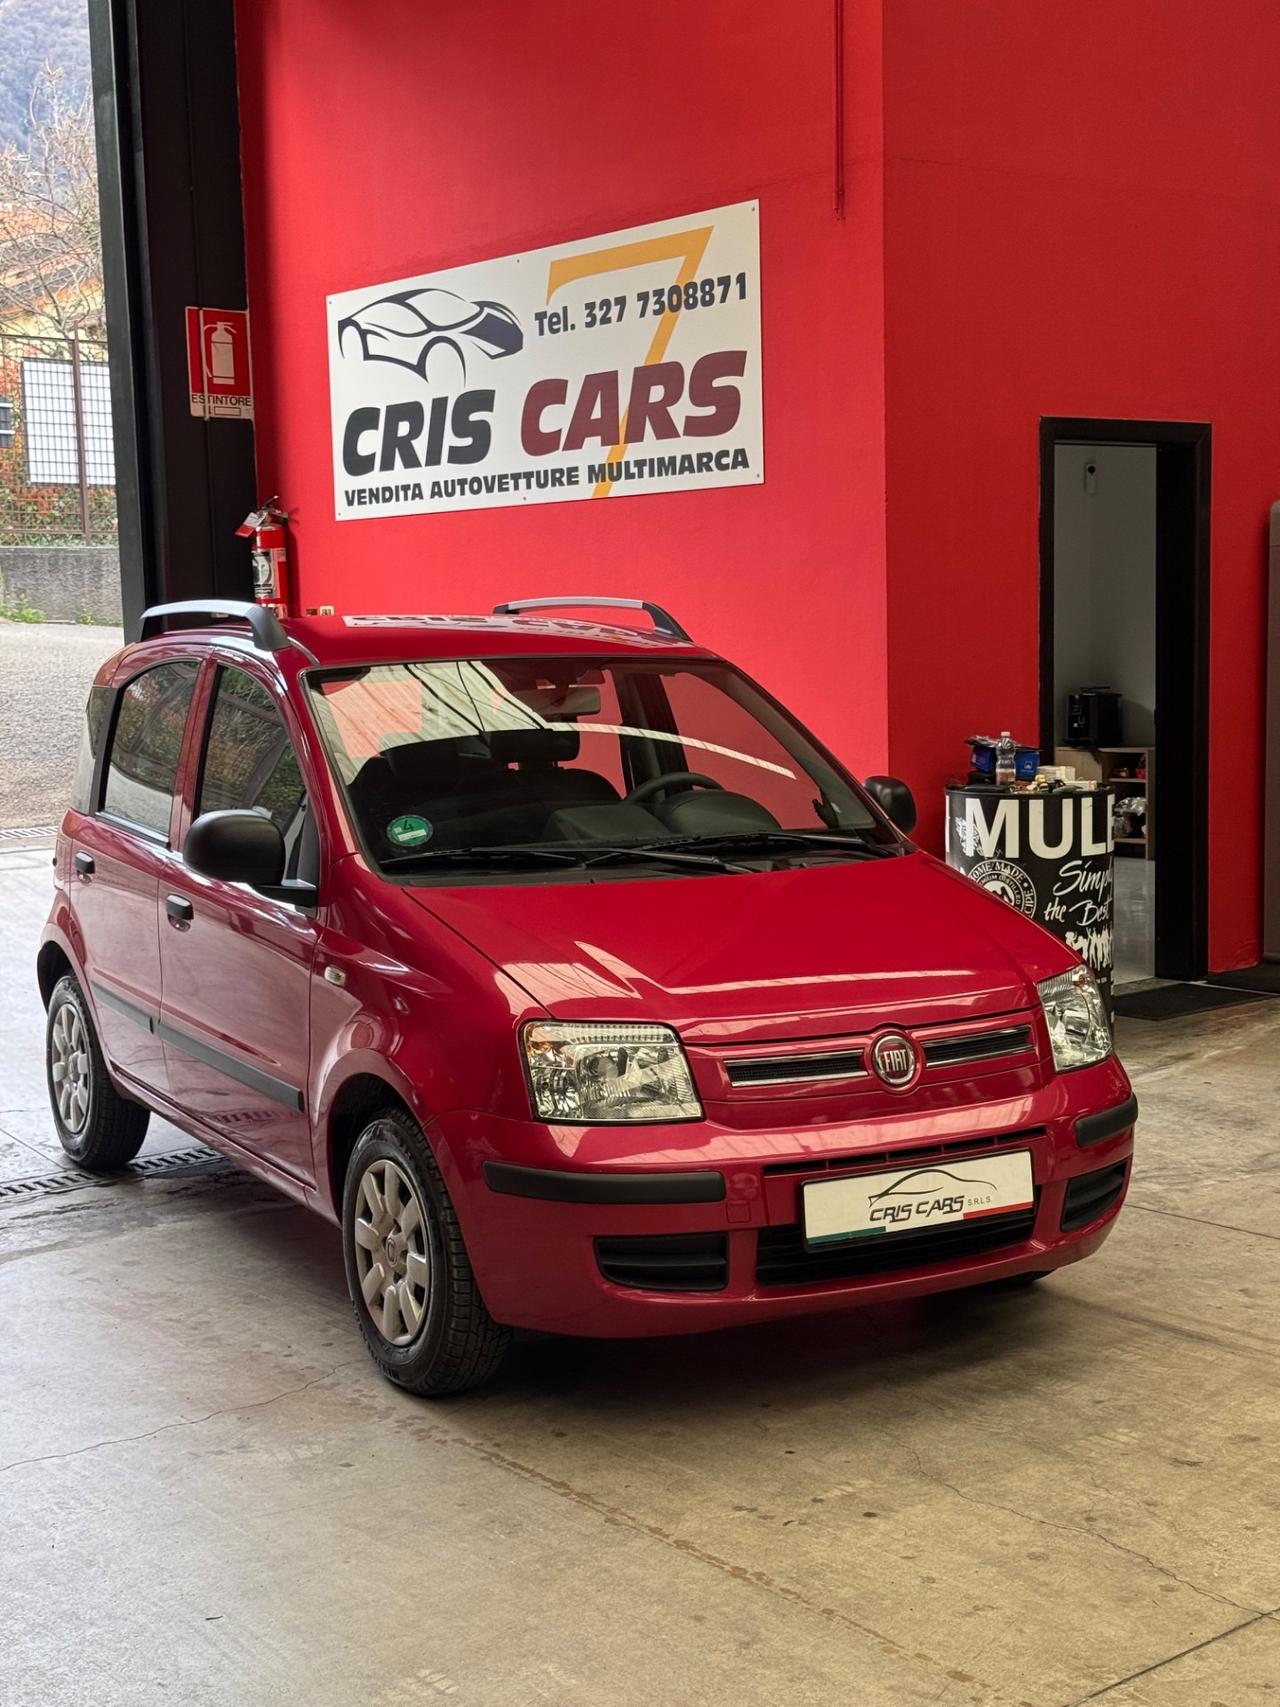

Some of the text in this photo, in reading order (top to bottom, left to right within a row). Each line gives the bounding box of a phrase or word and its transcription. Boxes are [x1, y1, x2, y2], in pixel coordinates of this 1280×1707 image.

[534, 271, 747, 336] Tel. 327 7308871
[191, 393, 252, 407] ESTINTORE
[342, 350, 747, 477] CRIS CARS
[344, 447, 750, 507] VENDITA AUTOVETTURE MULTIMARCA
[995, 861, 1025, 883] MADE
[1044, 897, 1112, 926] the Best
[883, 1049, 907, 1073] FIAT
[869, 1203, 913, 1224] CRIS
[915, 1195, 965, 1217] CARS
